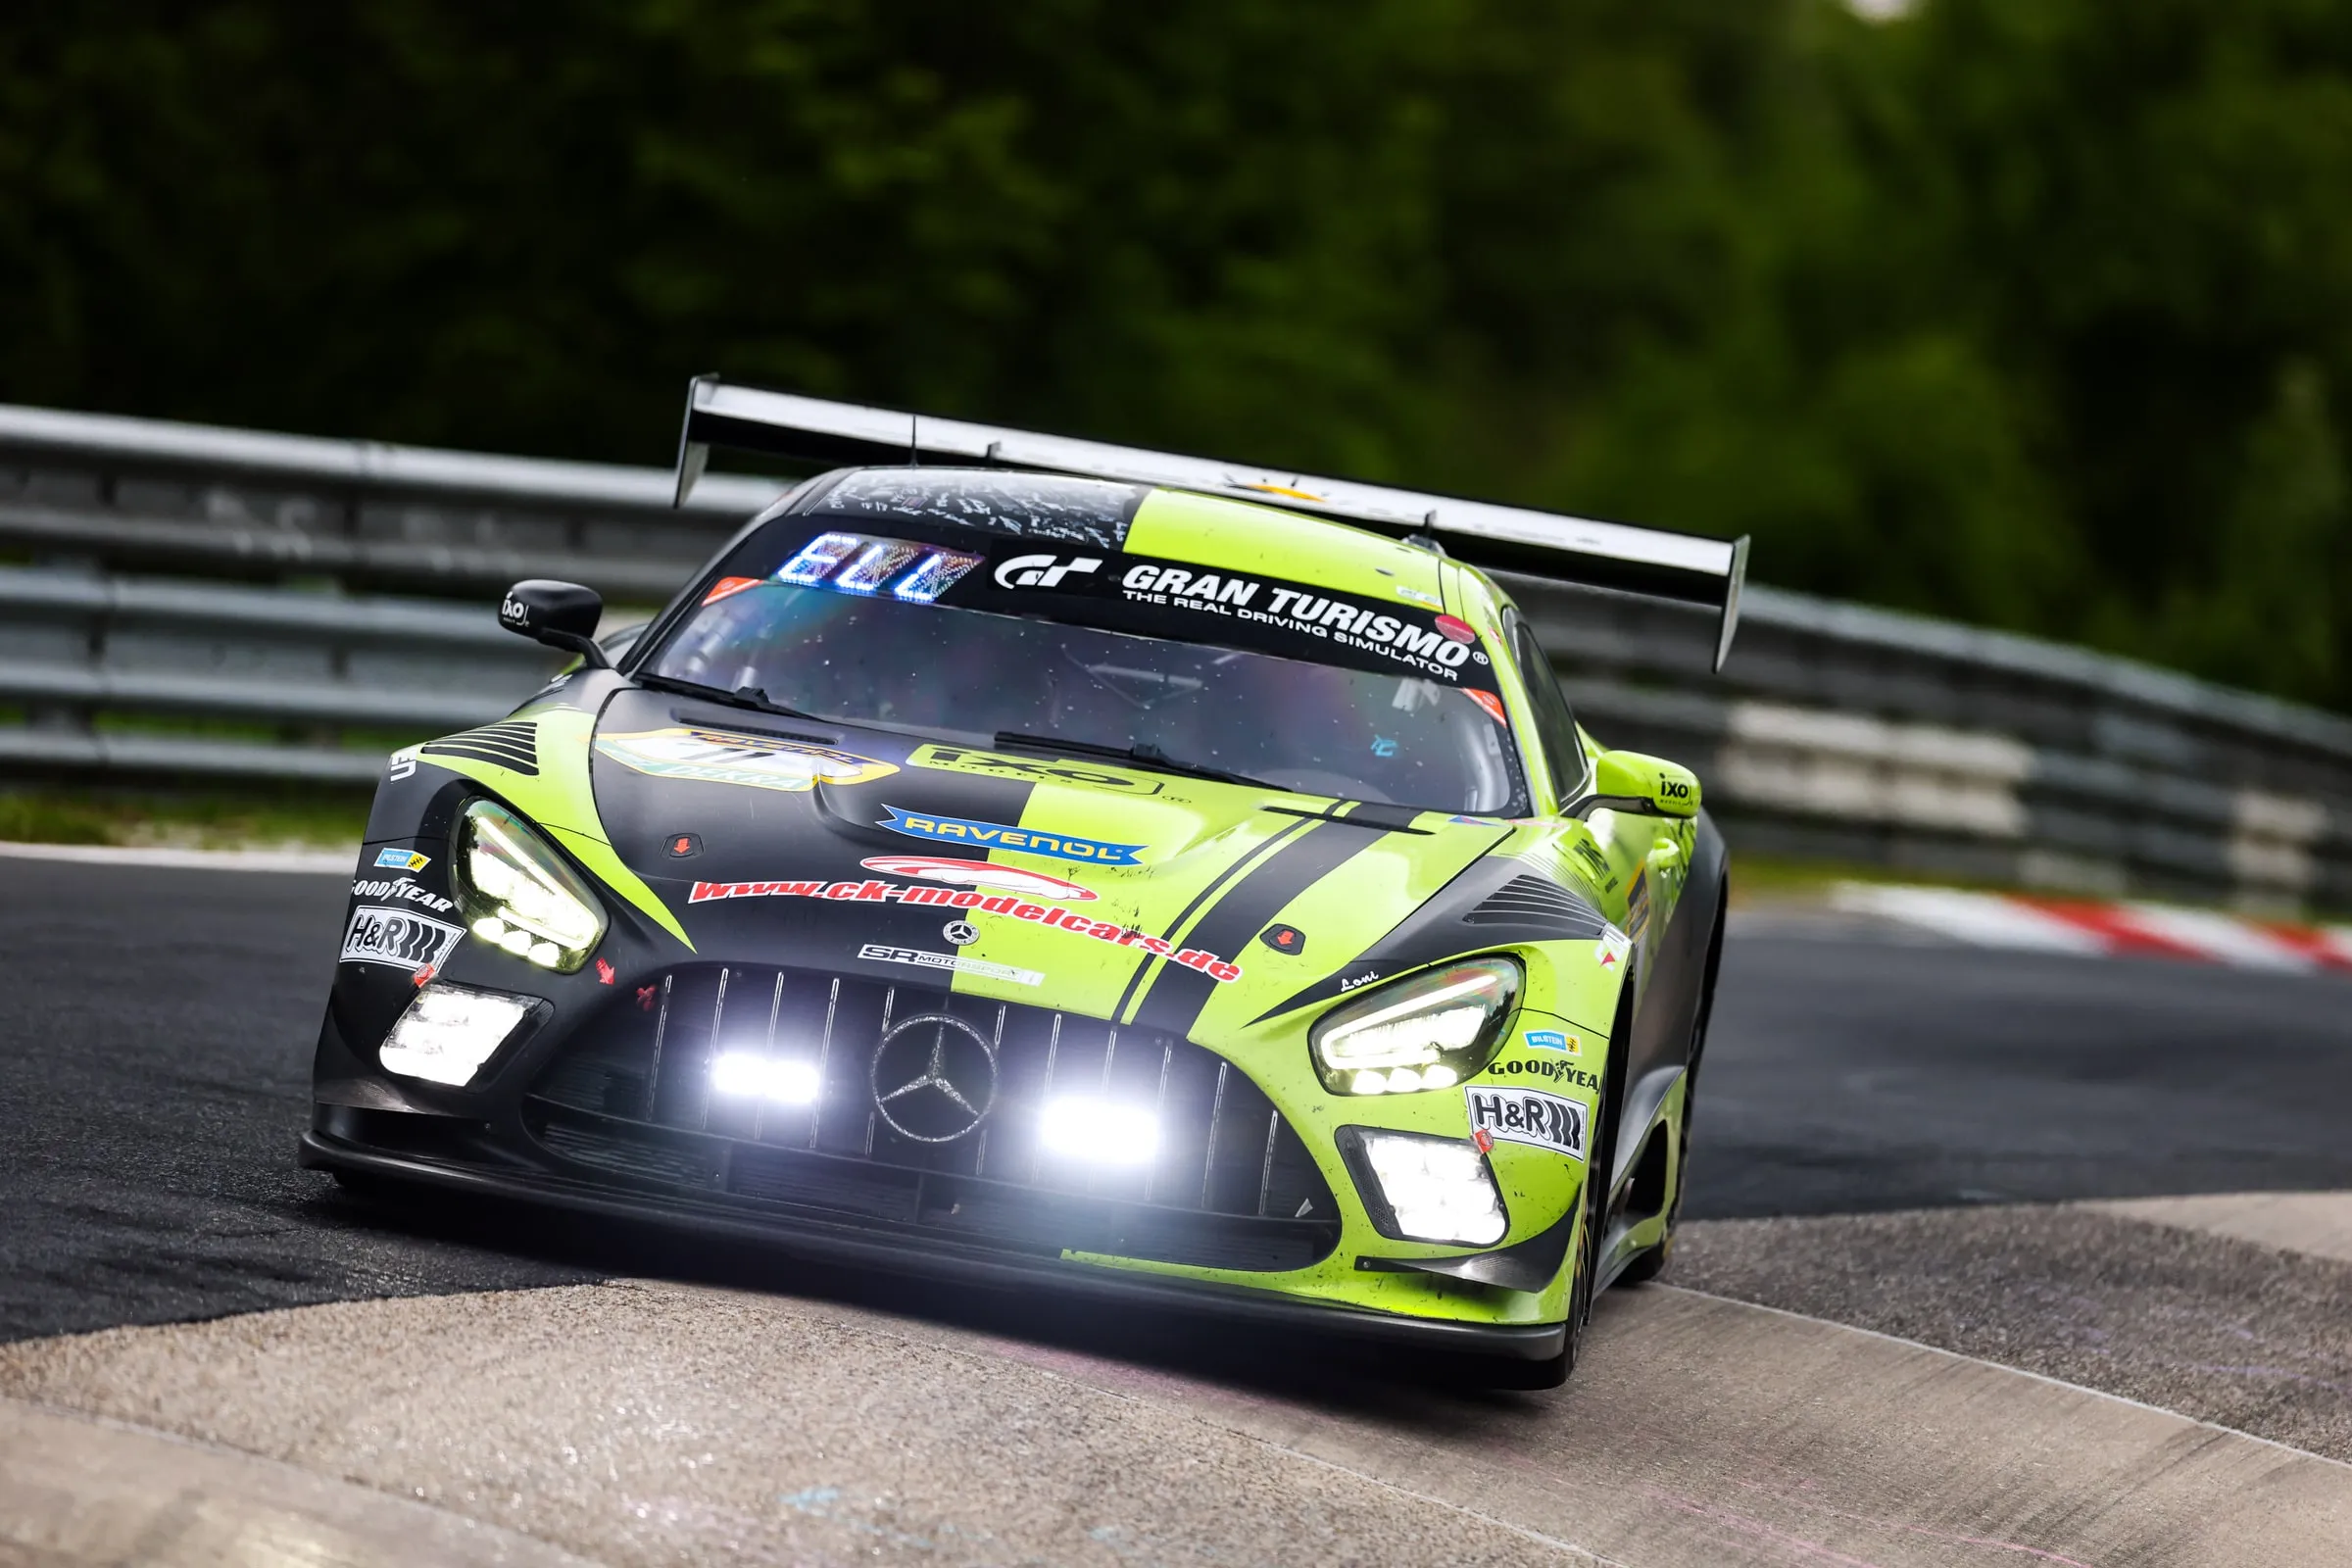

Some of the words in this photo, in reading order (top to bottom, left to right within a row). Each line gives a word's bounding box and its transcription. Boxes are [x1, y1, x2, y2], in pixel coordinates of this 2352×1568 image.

[1121, 564, 1260, 607] GRAN
[1267, 587, 1470, 668] TURISMO
[1122, 589, 1167, 605] THE
[1173, 598, 1232, 616] REAL
[1237, 608, 1328, 639] DRIVING
[1333, 631, 1459, 682] SIMULATOR
[1658, 772, 1690, 799] ixo
[905, 816, 1124, 860] RAVENOL
[346, 914, 407, 955] H&R
[688, 880, 1245, 983] www.ck-modelcars.de
[862, 946, 919, 962] SR
[1531, 1035, 1564, 1047] BILSTEIN
[1474, 1094, 1547, 1135] H&R
